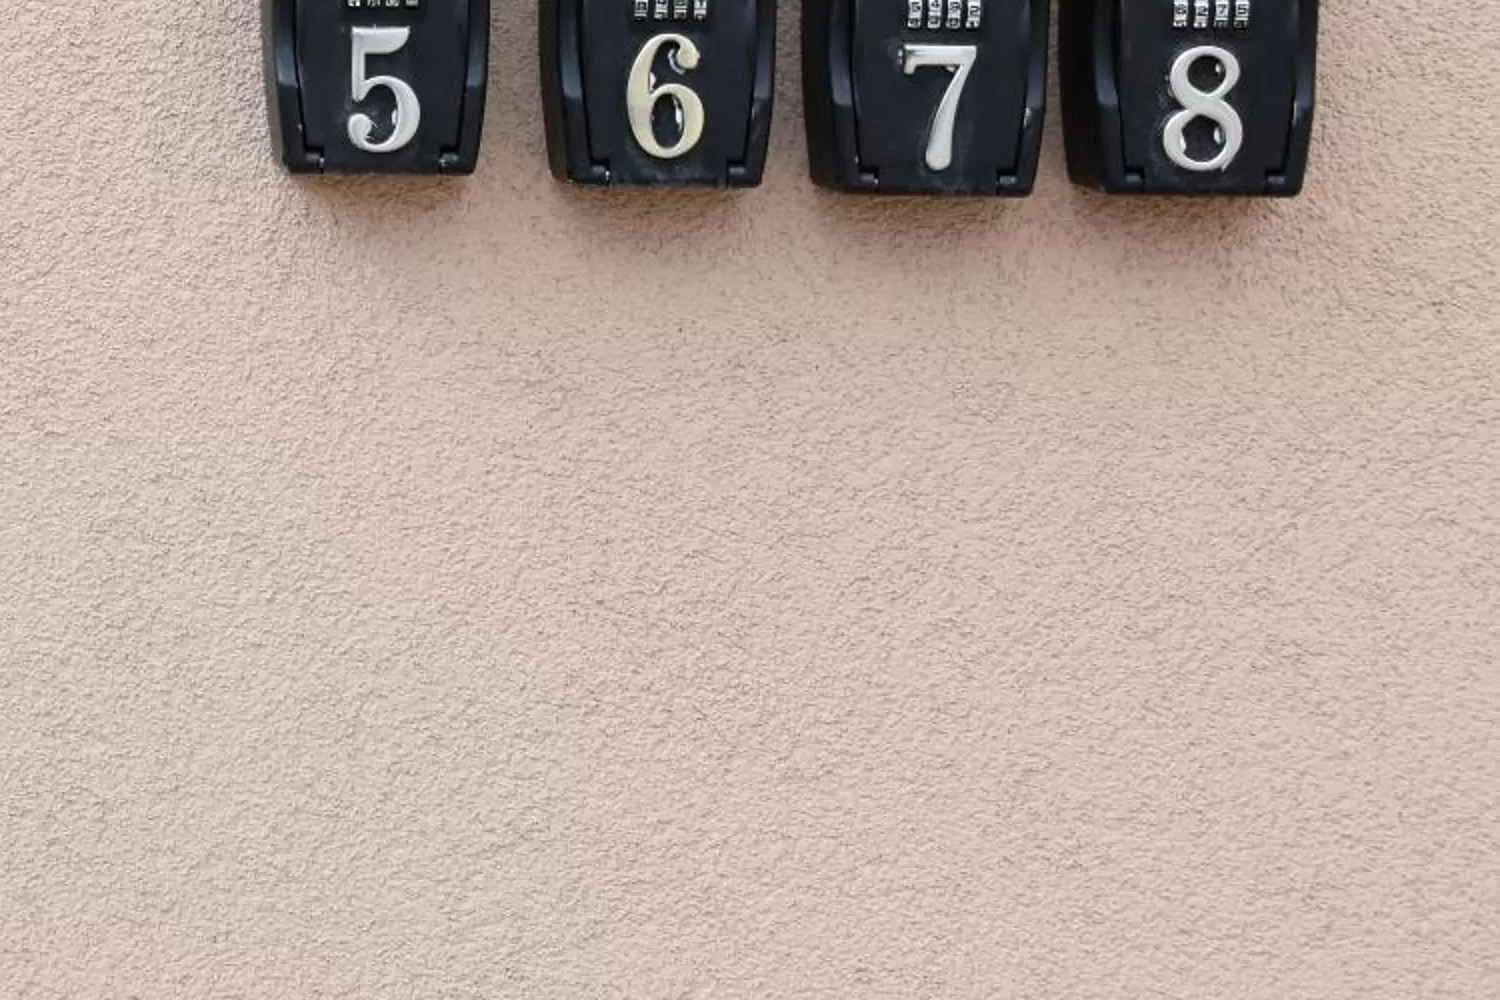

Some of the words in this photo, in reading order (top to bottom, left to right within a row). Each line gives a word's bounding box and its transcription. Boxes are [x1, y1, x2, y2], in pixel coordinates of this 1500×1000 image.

[347, 26, 421, 153] 5
[627, 33, 705, 158] 6
[903, 44, 977, 171] 7
[1163, 46, 1243, 172] 8
